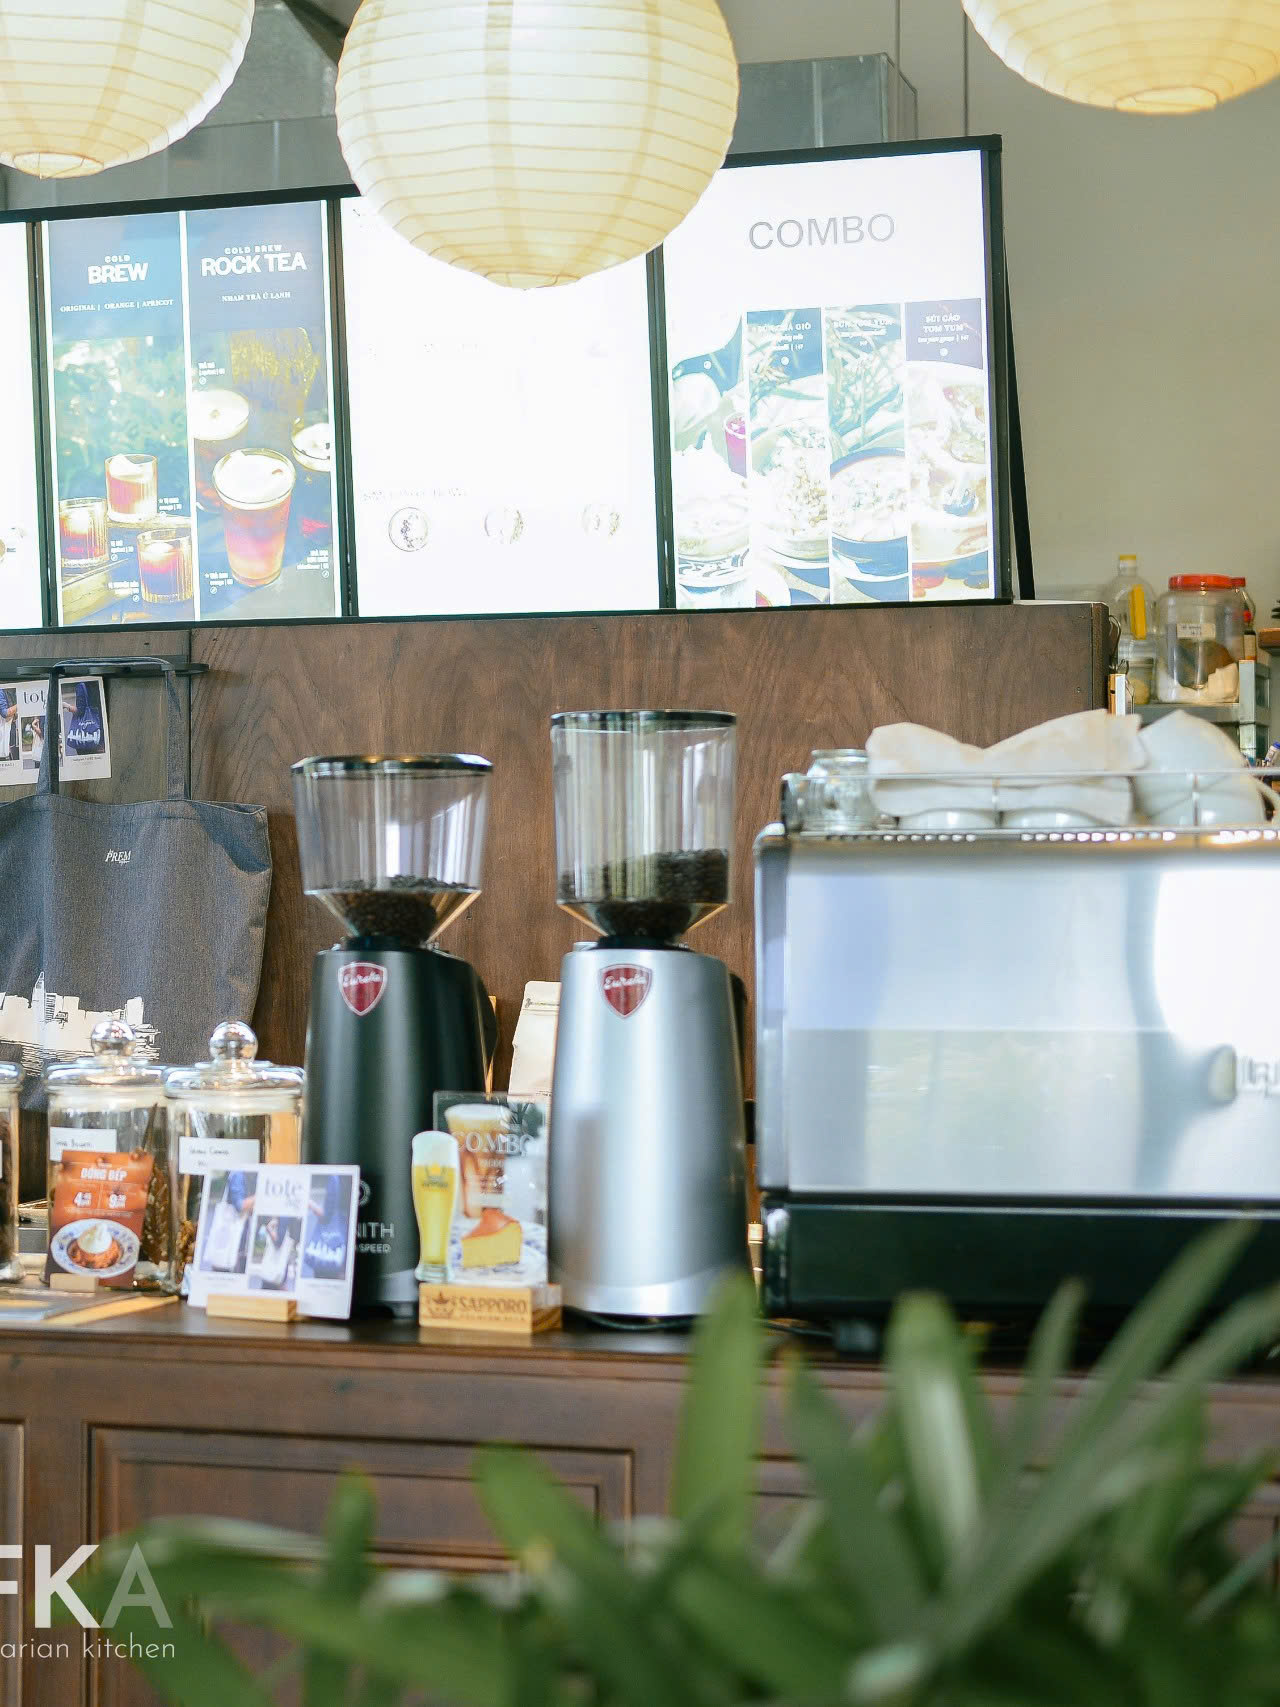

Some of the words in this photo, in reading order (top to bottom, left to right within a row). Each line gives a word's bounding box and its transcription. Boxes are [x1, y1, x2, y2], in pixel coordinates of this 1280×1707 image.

[748, 213, 896, 250] COMBO
[224, 247, 251, 255] COLD
[255, 244, 282, 252] BREW
[104, 255, 131, 263] COLD
[201, 254, 261, 277] ROCK
[264, 251, 307, 272] TEA
[88, 262, 149, 285] BREW
[23, 690, 48, 705] tot
[359, 1243, 391, 1254] SPEED
[460, 1296, 529, 1315] SAPPORO
